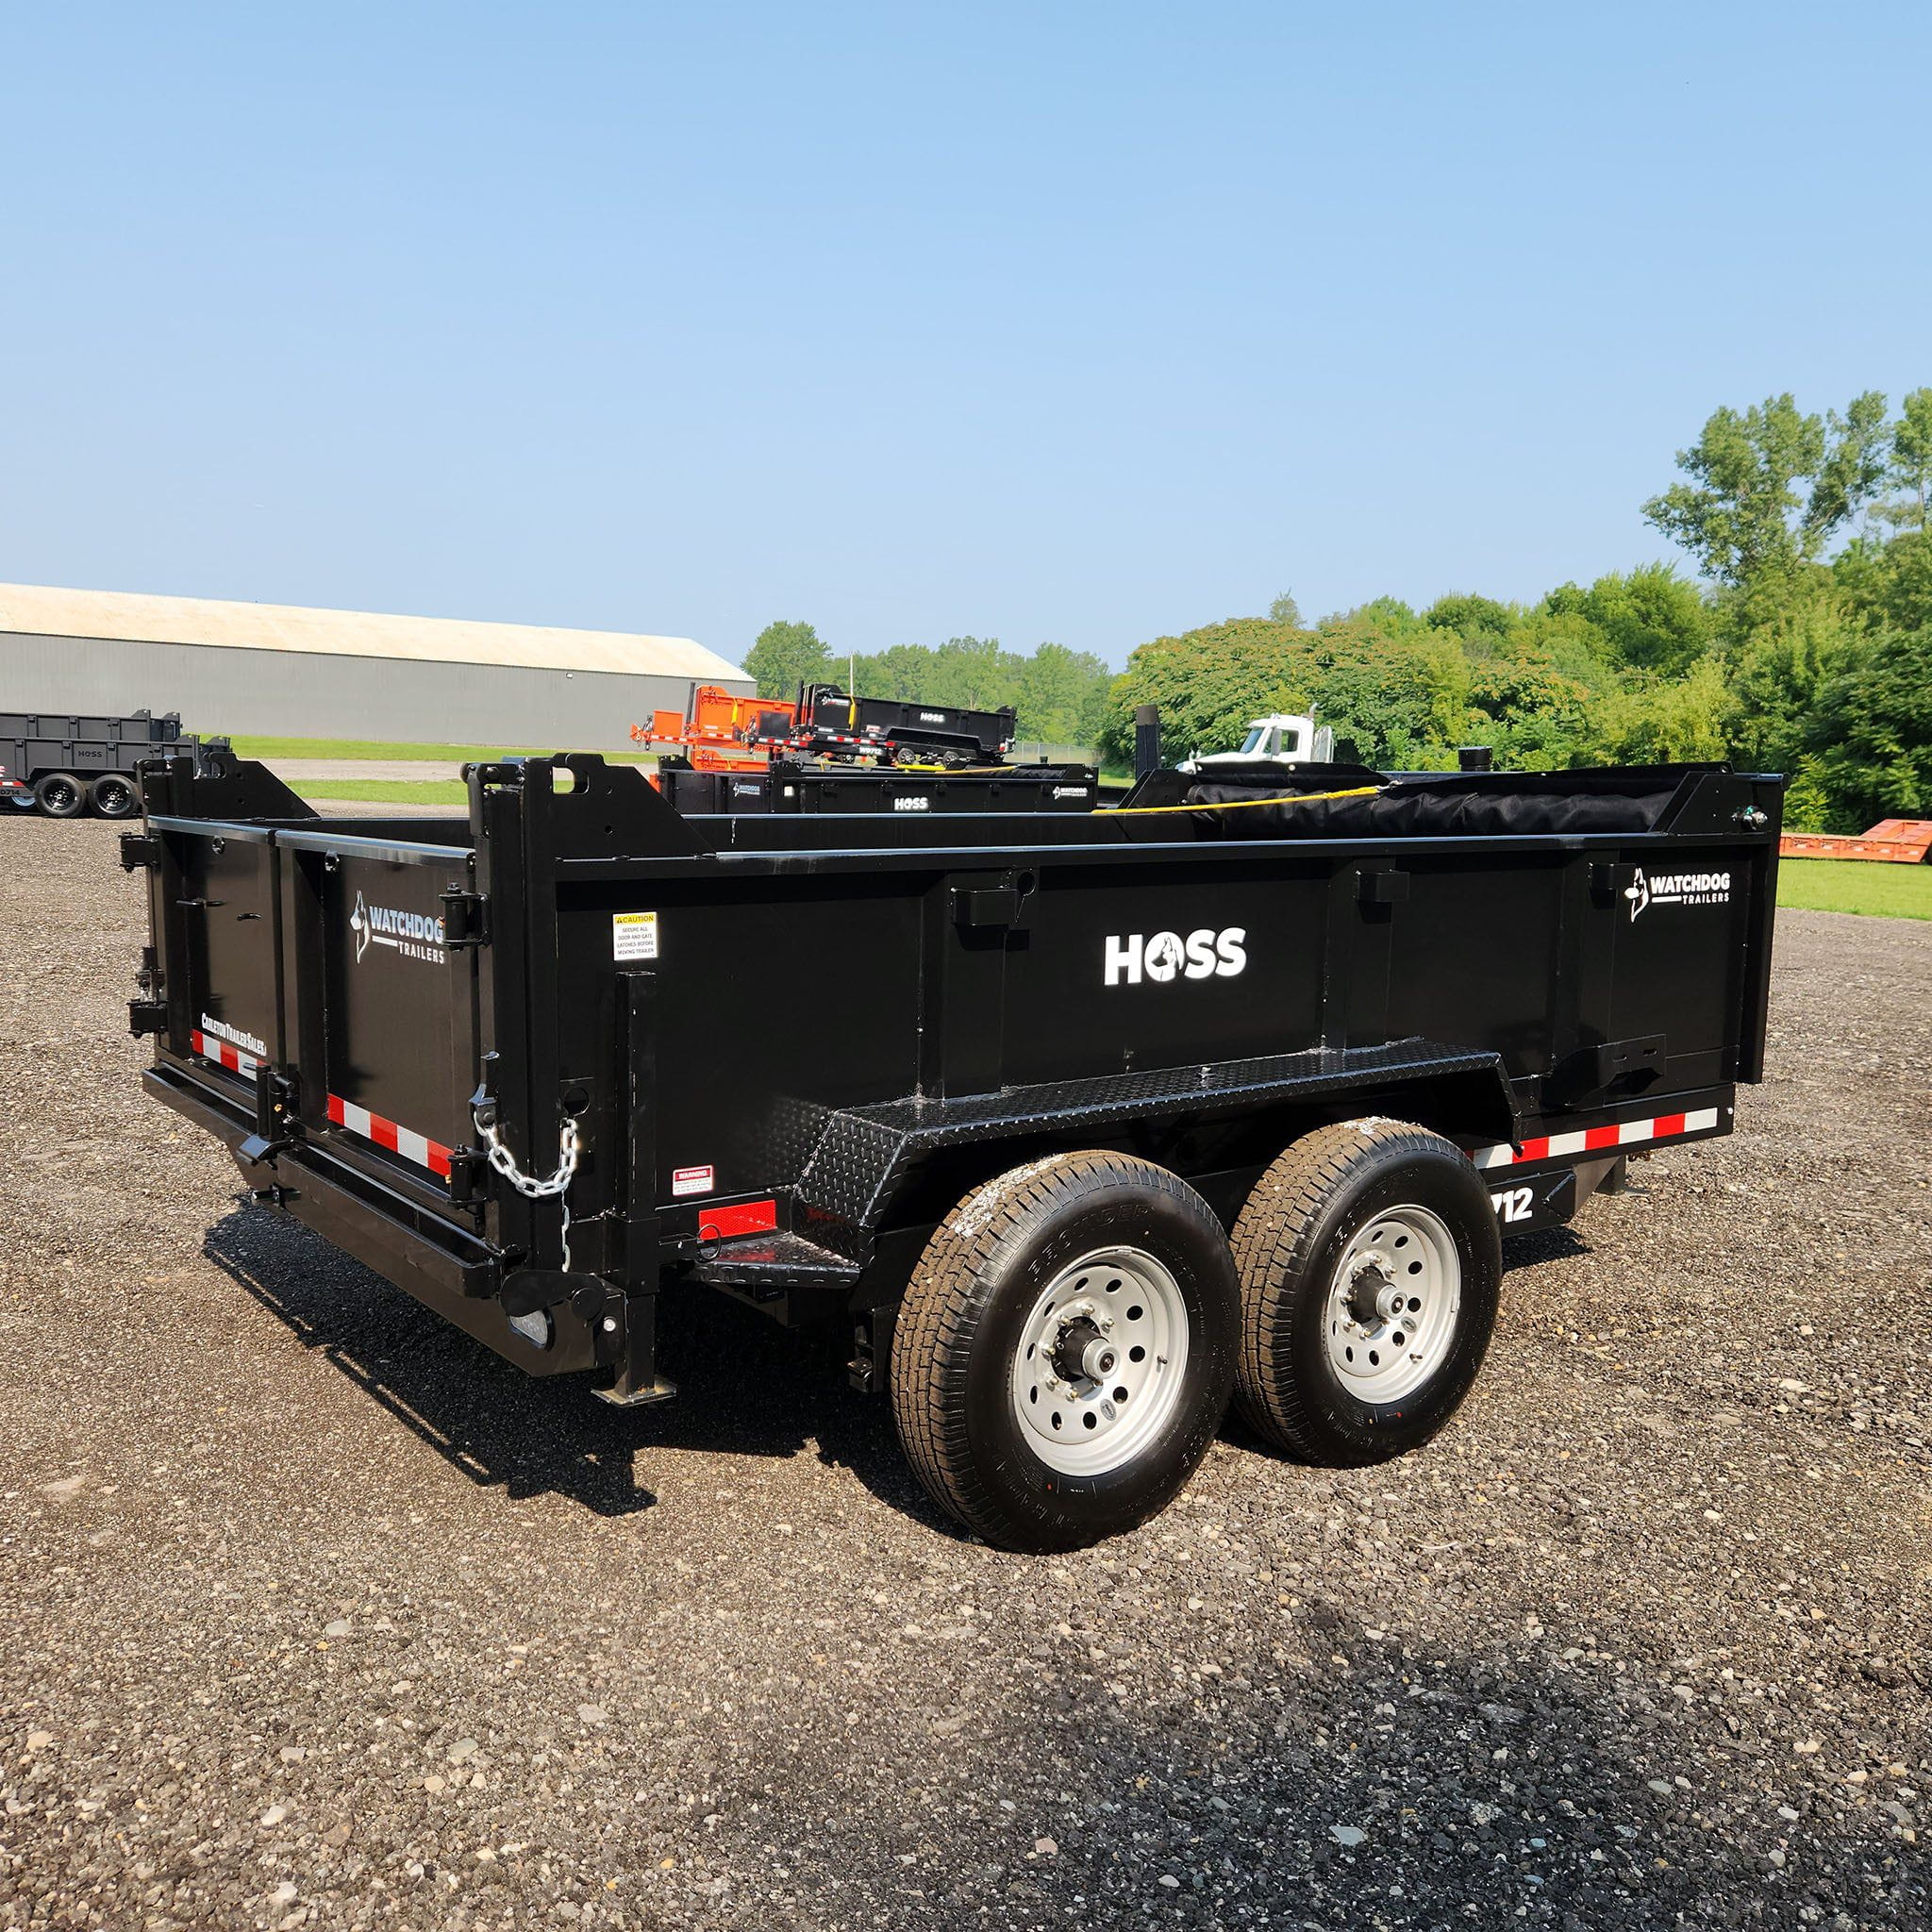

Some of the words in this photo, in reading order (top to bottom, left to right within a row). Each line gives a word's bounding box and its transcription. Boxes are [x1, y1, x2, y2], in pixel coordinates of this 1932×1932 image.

[894, 796, 929, 810] HOSS
[1650, 873, 1731, 894] WATCHDOG
[1683, 892, 1730, 905] TRAILERS
[369, 906, 444, 944] WATCHDOG
[623, 915, 654, 924] CAUTION
[398, 941, 445, 964] TRAILERS
[1105, 927, 1247, 985] HOSS
